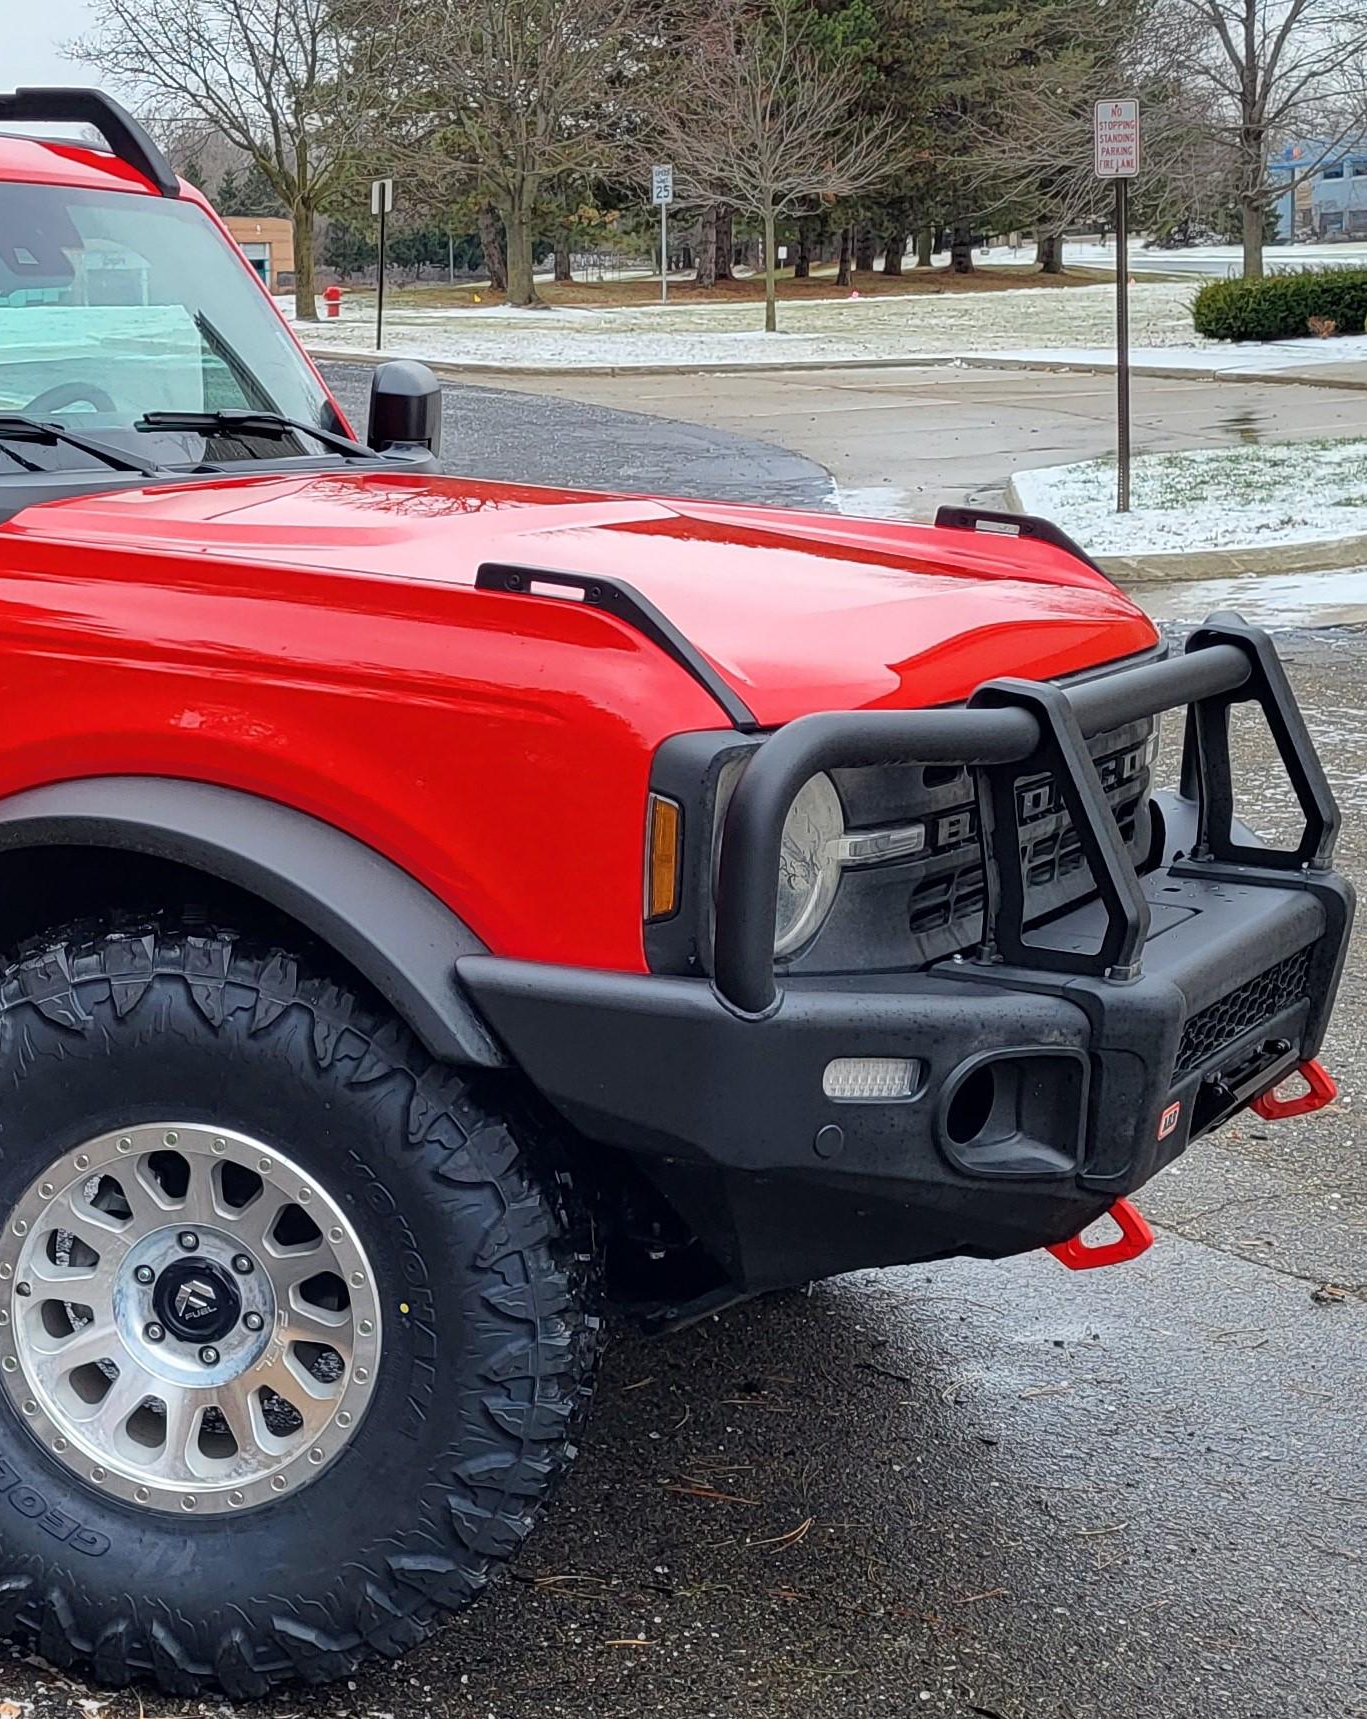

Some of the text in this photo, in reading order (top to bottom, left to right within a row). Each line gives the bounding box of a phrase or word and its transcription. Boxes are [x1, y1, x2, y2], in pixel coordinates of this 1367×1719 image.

[1111, 107, 1123, 117] NO
[1099, 120, 1136, 131] STOPPING
[1099, 133, 1135, 144] STANDING
[1101, 146, 1132, 156] PARKING
[1100, 159, 1134, 169] FIRE LANE
[656, 185, 670, 199] 25
[185, 1306, 218, 1321] FUEL
